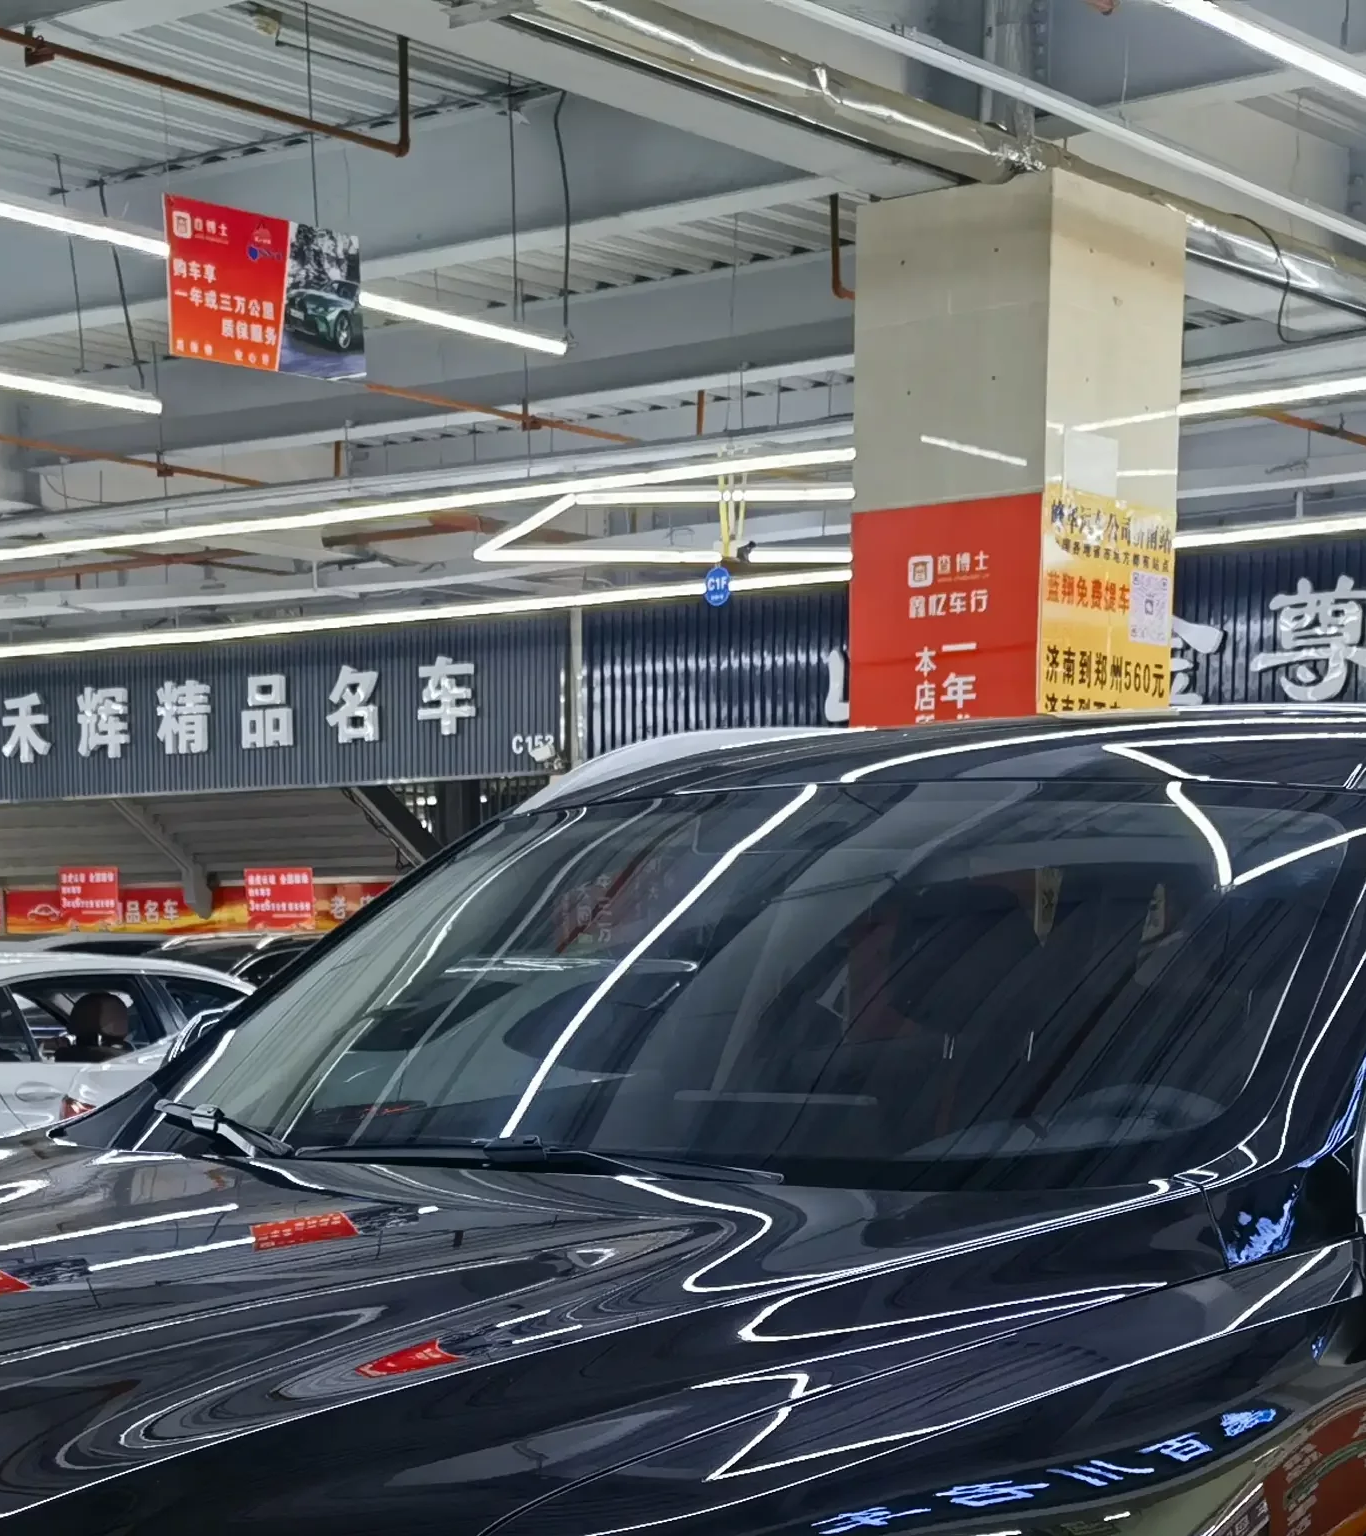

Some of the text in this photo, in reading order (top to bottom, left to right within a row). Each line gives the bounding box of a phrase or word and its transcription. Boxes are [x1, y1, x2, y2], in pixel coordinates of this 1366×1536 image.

[1046, 645, 1165, 698] 济南到郑州560元
[1, 655, 477, 764] 禾辉精品名车
[119, 898, 179, 925] 品名车
